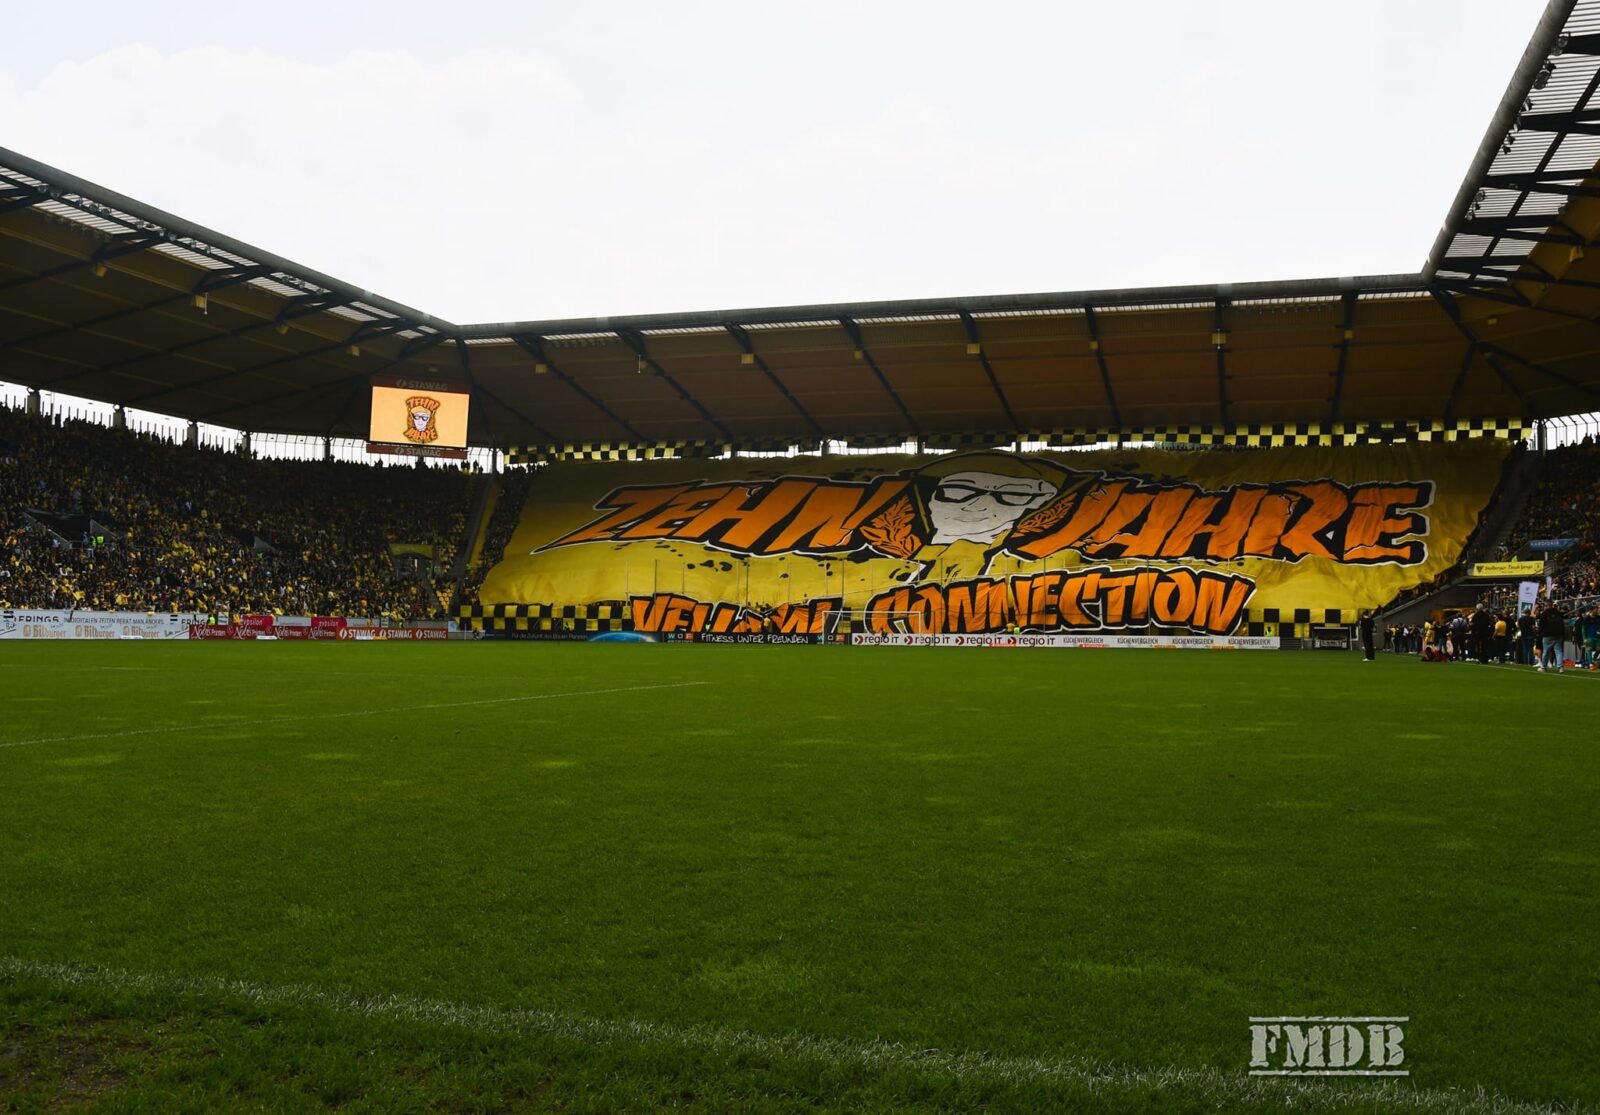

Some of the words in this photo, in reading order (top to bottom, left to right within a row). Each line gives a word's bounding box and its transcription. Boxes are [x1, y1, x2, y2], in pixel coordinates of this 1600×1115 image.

[408, 380, 448, 391] STAWAG
[406, 448, 441, 457] STAWAG
[530, 476, 912, 558] ZEHN
[1006, 480, 1436, 566] JAHRE
[863, 566, 1256, 635] CONNECTION
[33, 624, 66, 638] Bitburger
[84, 625, 115, 638] Bitburger
[348, 628, 376, 639] STAWAG
[387, 628, 413, 639] STAWAG
[423, 629, 447, 639] STAWAG
[701, 632, 735, 643] FITNESS
[737, 634, 764, 643] UNTER
[767, 634, 808, 644] FREUNDEN
[865, 634, 889, 645] regio
[915, 635, 940, 646] regio
[966, 635, 992, 646] regio
[1018, 636, 1043, 647] regio
[1117, 637, 1158, 645] KÜCHENVERGLEICH
[1228, 638, 1270, 646] KÜCHENVERGLEICH
